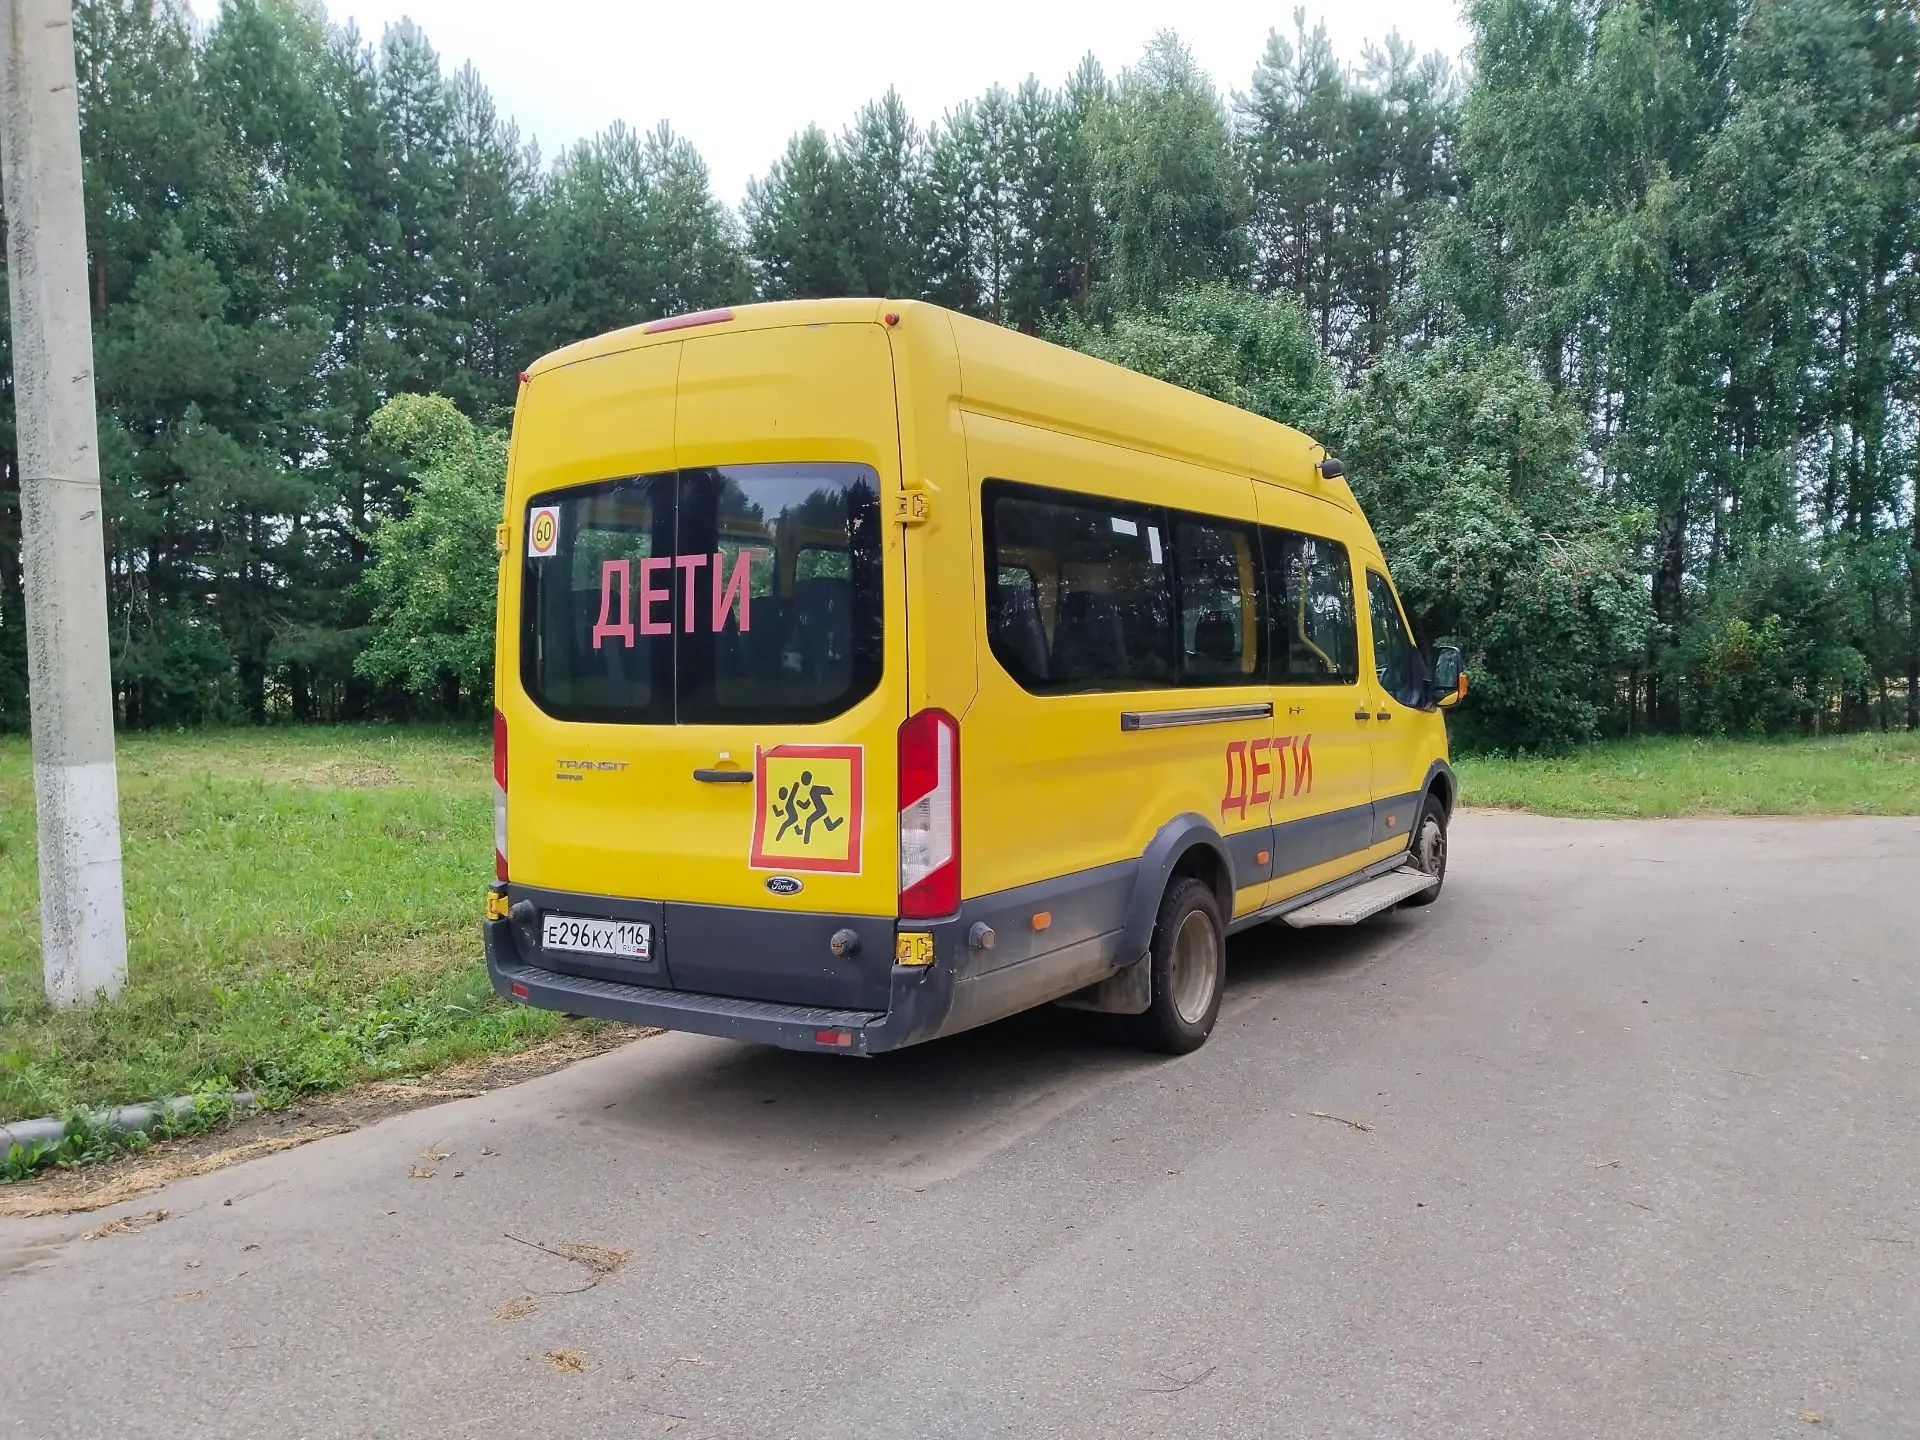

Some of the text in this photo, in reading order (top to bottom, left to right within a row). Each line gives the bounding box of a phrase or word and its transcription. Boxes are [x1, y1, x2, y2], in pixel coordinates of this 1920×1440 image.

[536, 521, 551, 542] 60
[592, 551, 751, 649] ДЕТИ
[556, 759, 630, 771] TRANSIT
[1221, 733, 1313, 824] ДЕТИ
[771, 879, 794, 891] Ford
[618, 925, 645, 945] 116
[622, 944, 637, 953] RUS
